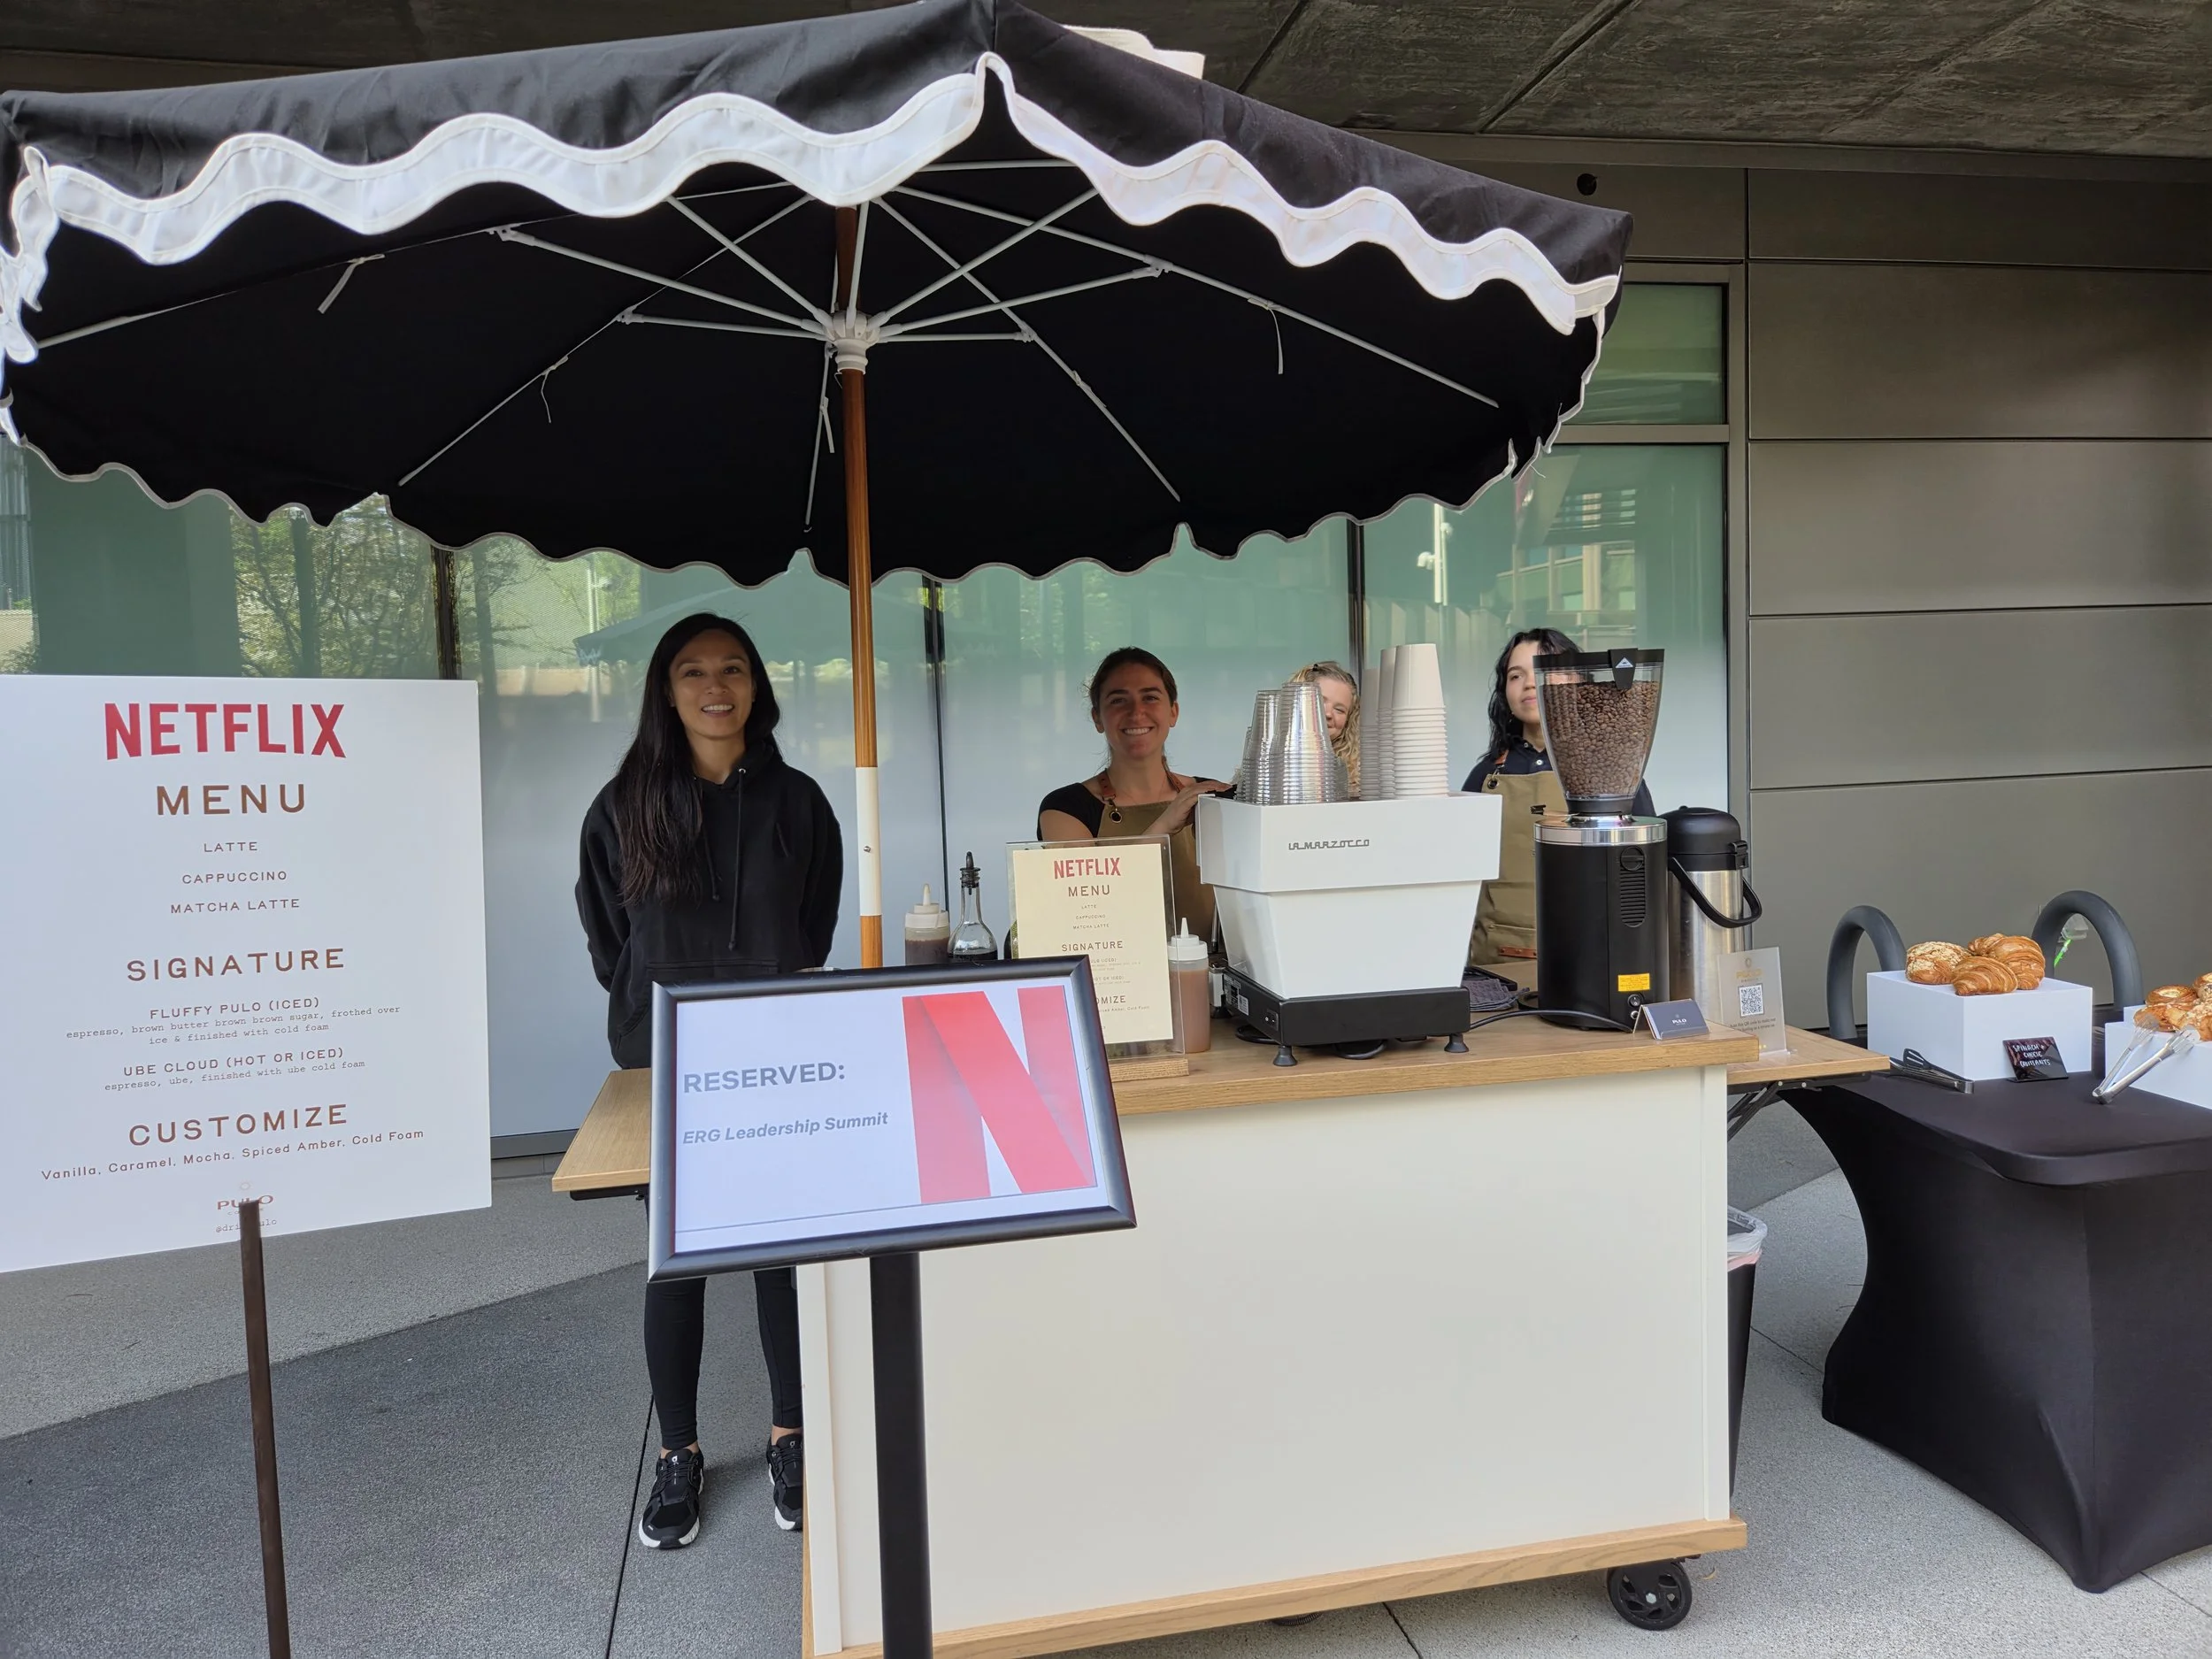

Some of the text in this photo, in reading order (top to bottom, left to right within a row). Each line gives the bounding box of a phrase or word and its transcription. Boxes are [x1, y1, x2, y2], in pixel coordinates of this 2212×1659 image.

[104, 703, 346, 760] NETFLIX
[156, 783, 306, 816] MENU
[203, 841, 258, 853] LATTE
[181, 871, 288, 885] CAPPUCCINO
[1054, 857, 1121, 879] NETFLIX
[1068, 885, 1110, 897] MENU
[170, 898, 301, 914] MATCHA LATTE
[1062, 941, 1124, 952] SIGNATURE
[127, 948, 345, 982] SIGNATURE
[150, 996, 319, 1019] FLUFFY PULO (ICED)
[66, 1028, 124, 1040] espresso,
[132, 1025, 165, 1033] brown
[170, 1020, 209, 1030] butter
[214, 1018, 247, 1026] brown
[252, 1014, 283, 1024] brown
[289, 1012, 324, 1023] sugar,
[331, 1008, 372, 1018] frothed
[149, 1036, 168, 1045] ice
[187, 1030, 238, 1041] finished
[243, 1028, 268, 1037] with
[274, 1025, 299, 1034] cold
[123, 1047, 343, 1077] UBE CLOUD (HOT OR ICED)
[104, 1080, 161, 1092] espresso,
[169, 1076, 193, 1085] ube,
[201, 1071, 251, 1082] finished
[288, 1064, 306, 1073] ube
[311, 1063, 335, 1071] cold
[683, 1062, 846, 1094] RESERVED:
[128, 1103, 348, 1147] CUSTOMIZE
[682, 1111, 889, 1145] ERG Leadership Summit
[41, 1130, 424, 1180] Vanilla, Caramel, Mocha, Spiced Amber, Cold Foam
